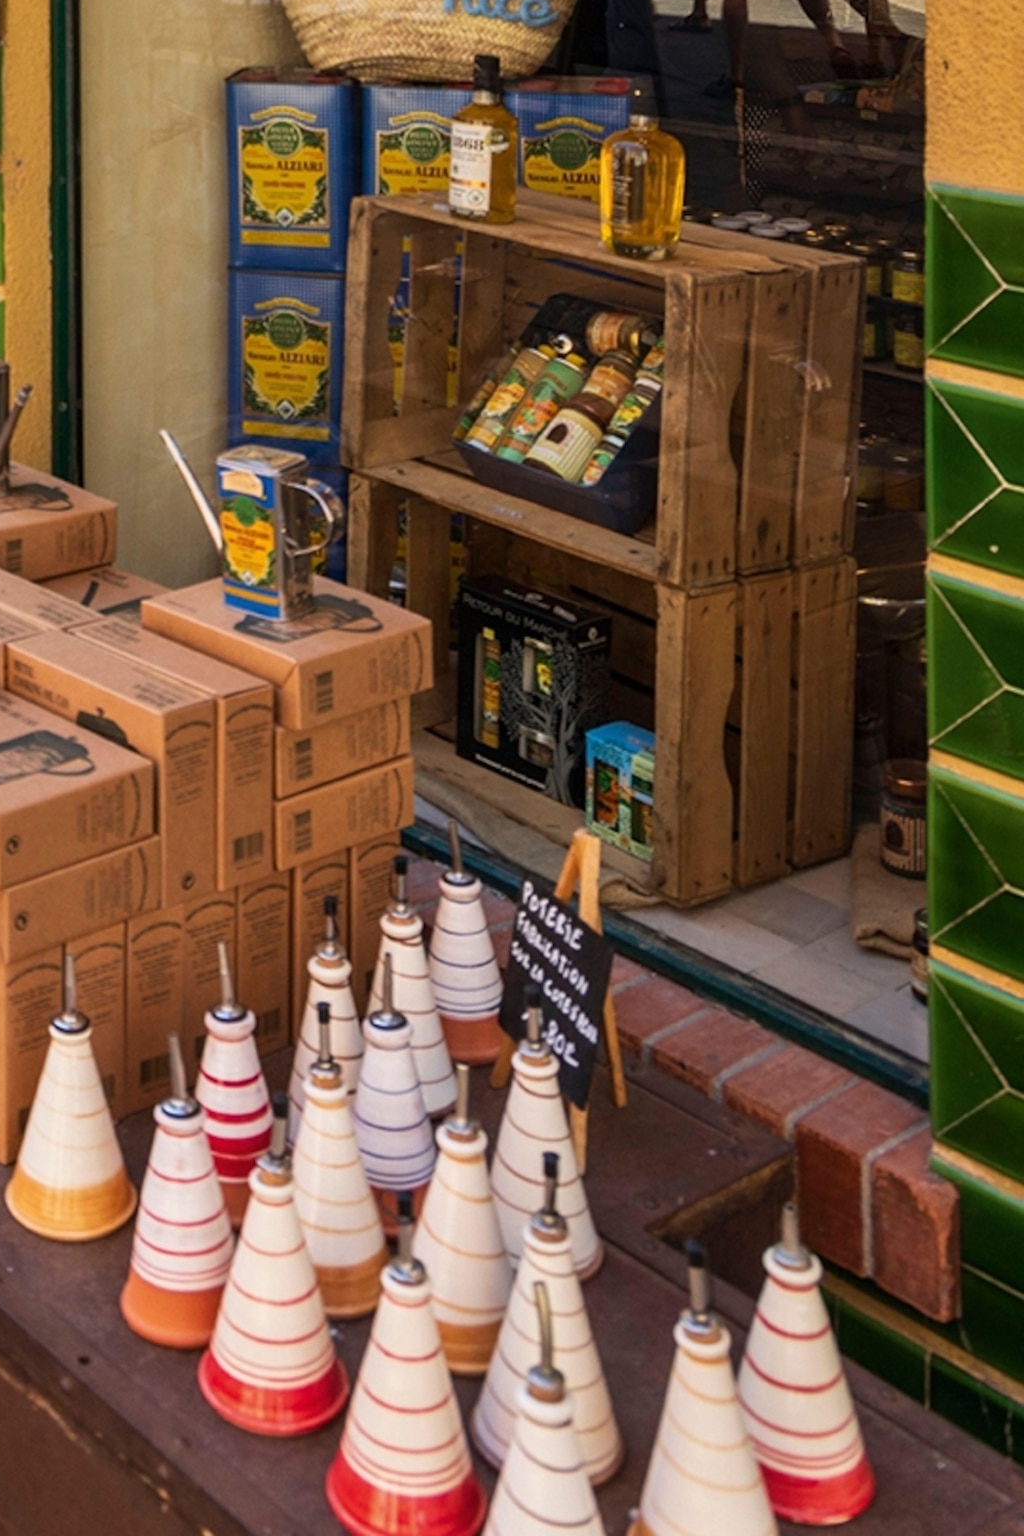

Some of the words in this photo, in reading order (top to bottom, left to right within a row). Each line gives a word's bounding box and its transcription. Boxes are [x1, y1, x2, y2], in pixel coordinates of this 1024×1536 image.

[277, 160, 324, 172] ALZIARI
[416, 166, 450, 178] ALZIA
[561, 172, 601, 185] ALZIA
[279, 350, 326, 366] ALZIARI
